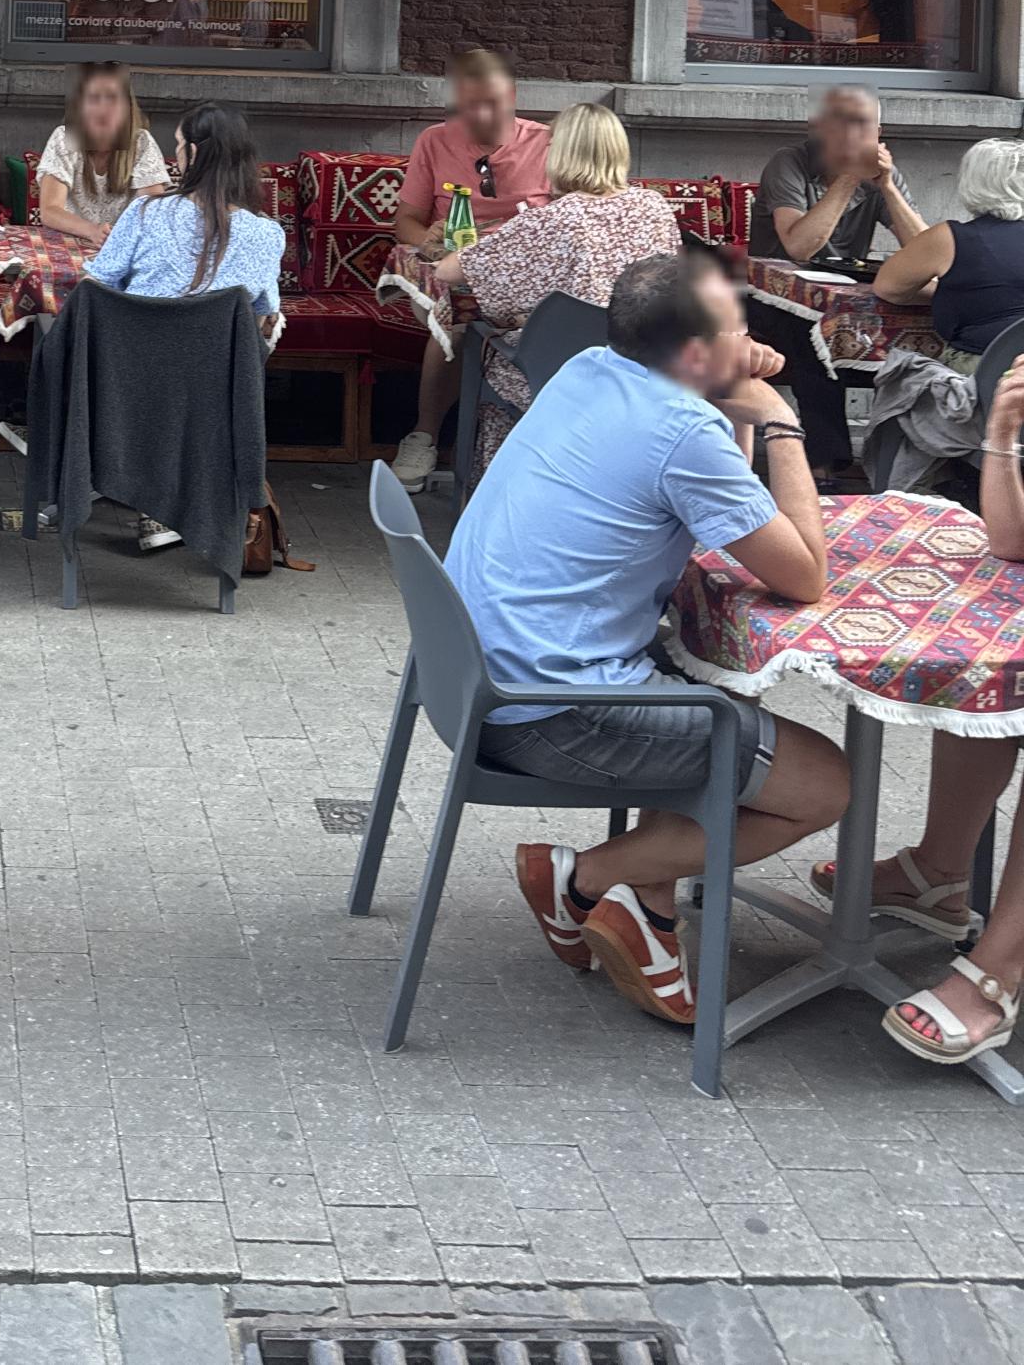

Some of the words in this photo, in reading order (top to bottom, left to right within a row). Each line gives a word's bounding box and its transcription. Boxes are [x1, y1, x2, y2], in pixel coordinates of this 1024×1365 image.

[26, 16, 66, 27] mezze,
[68, 16, 111, 28] caviare
[188, 19, 241, 31] houmous
